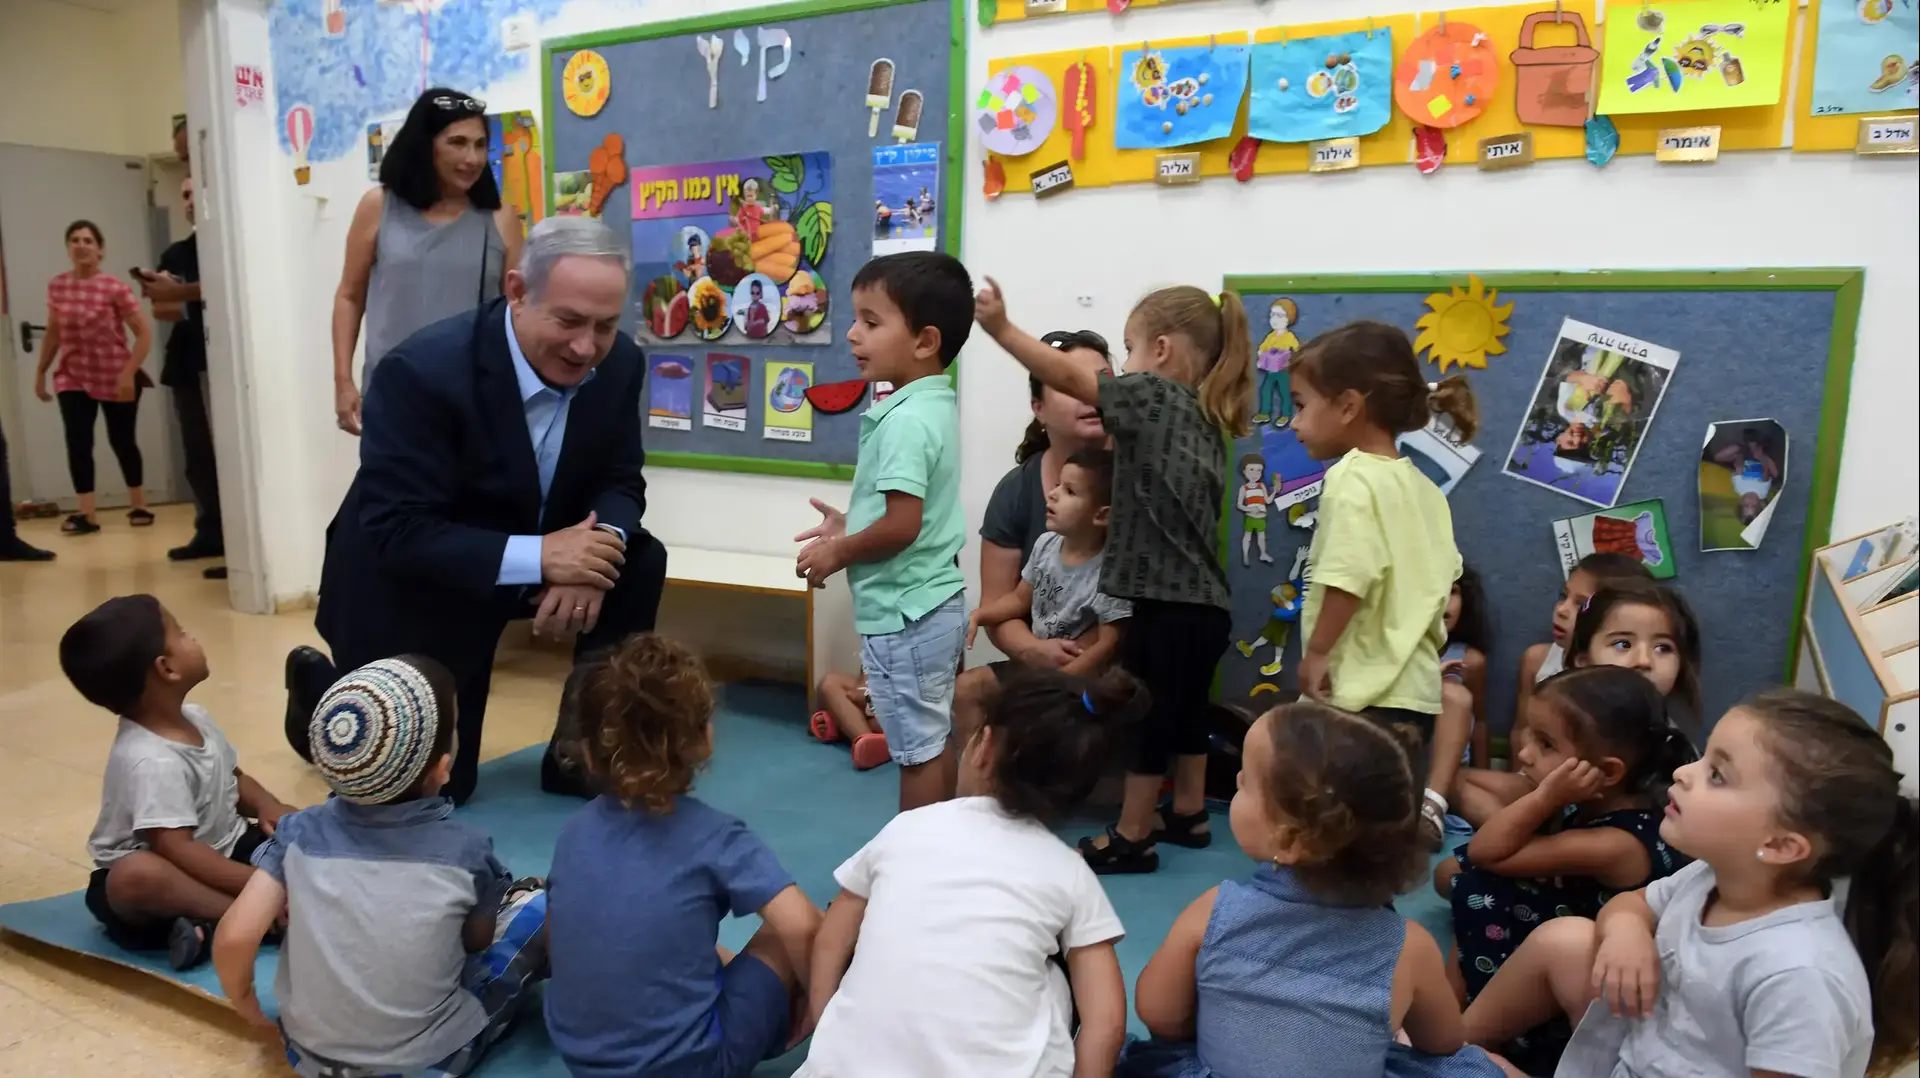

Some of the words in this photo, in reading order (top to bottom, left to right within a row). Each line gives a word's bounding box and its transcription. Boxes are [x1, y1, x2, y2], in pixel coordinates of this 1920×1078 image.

[696, 26, 792, 108] קיץ
[1873, 130, 1882, 139] ב
[1885, 127, 1910, 139] אדל
[1487, 142, 1520, 157] איתי
[1665, 135, 1711, 149] אימרי
[1317, 146, 1352, 160] אילור
[1048, 167, 1071, 183] יהלי
[1161, 161, 1190, 174] אליה
[640, 178, 679, 212] הקיץ
[682, 175, 712, 201] כמו
[715, 173, 740, 206] אין
[1587, 333, 1616, 348] שדה
[1558, 532, 1571, 549] קיץ
